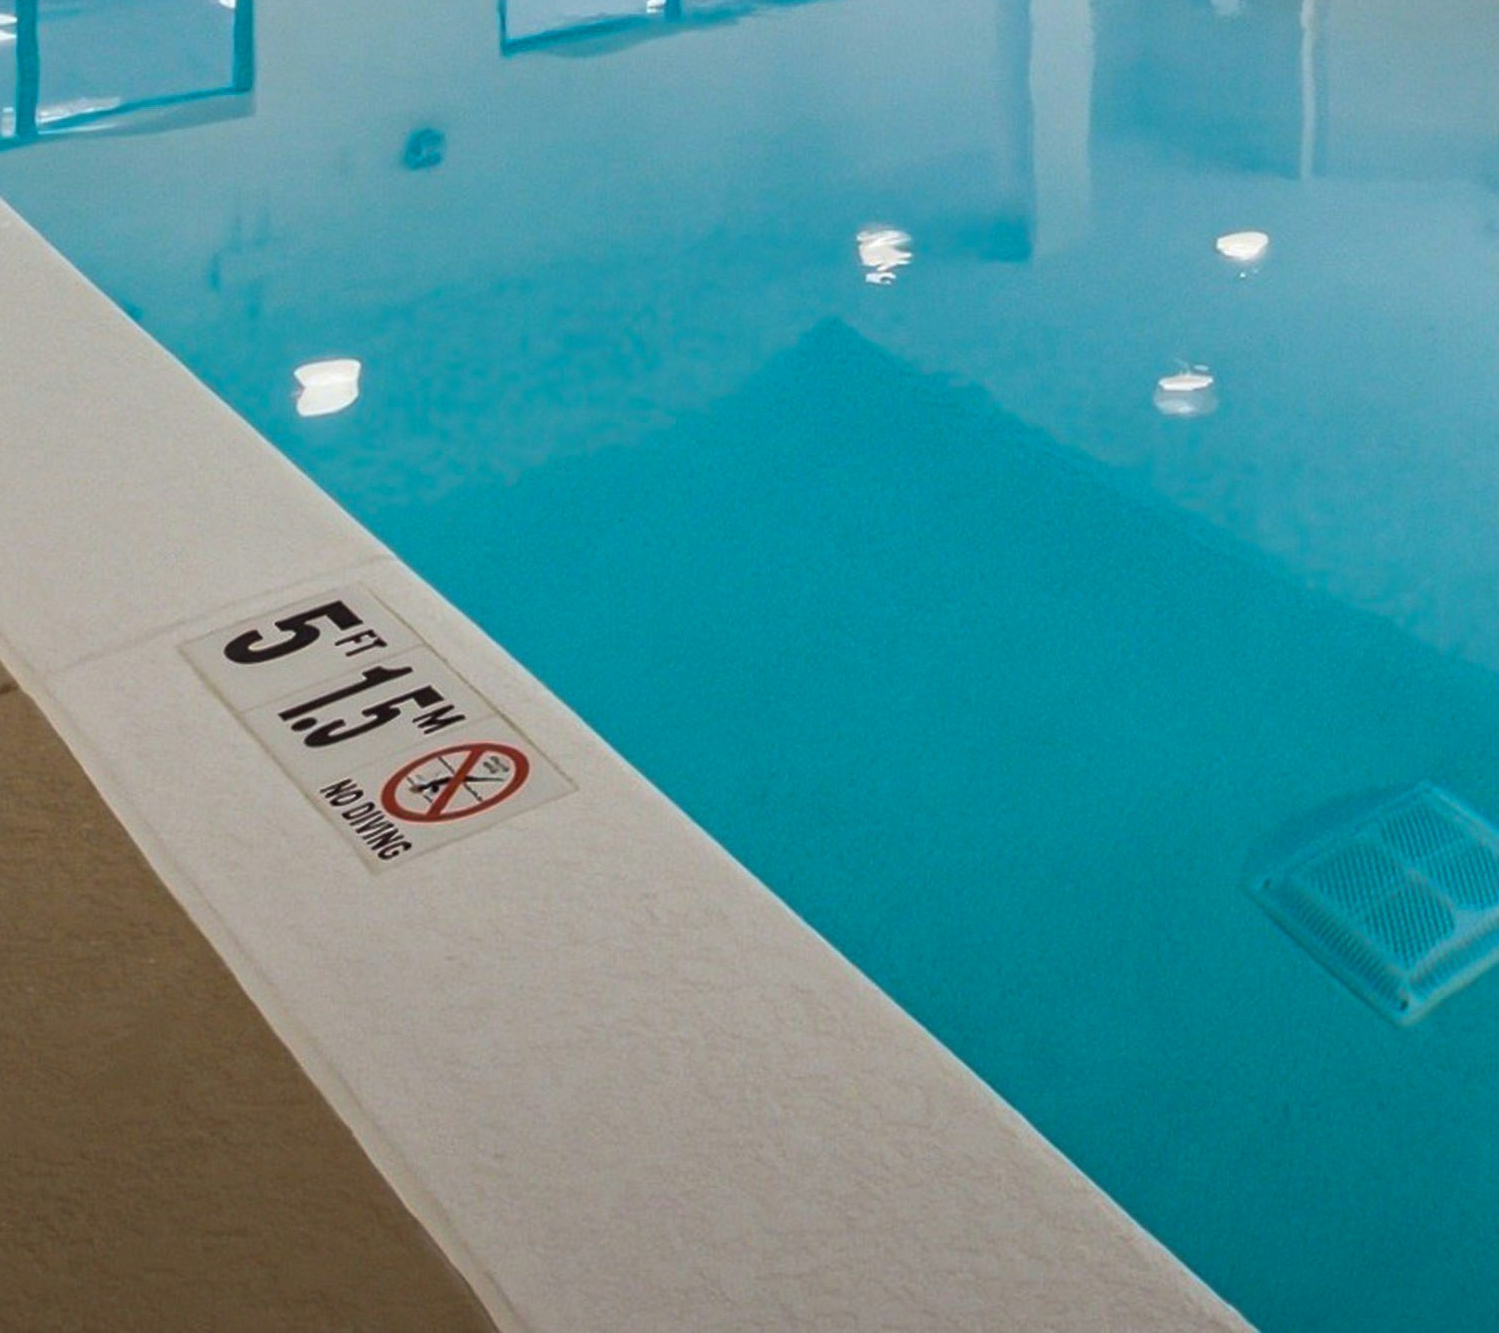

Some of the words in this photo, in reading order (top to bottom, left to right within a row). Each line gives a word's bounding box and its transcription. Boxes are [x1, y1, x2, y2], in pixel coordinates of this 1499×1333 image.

[223, 599, 364, 665] 5
[334, 628, 388, 657] FT
[277, 665, 445, 748] 1.5
[411, 703, 467, 735] M
[320, 778, 364, 808] NO
[341, 801, 413, 861] DIVING
